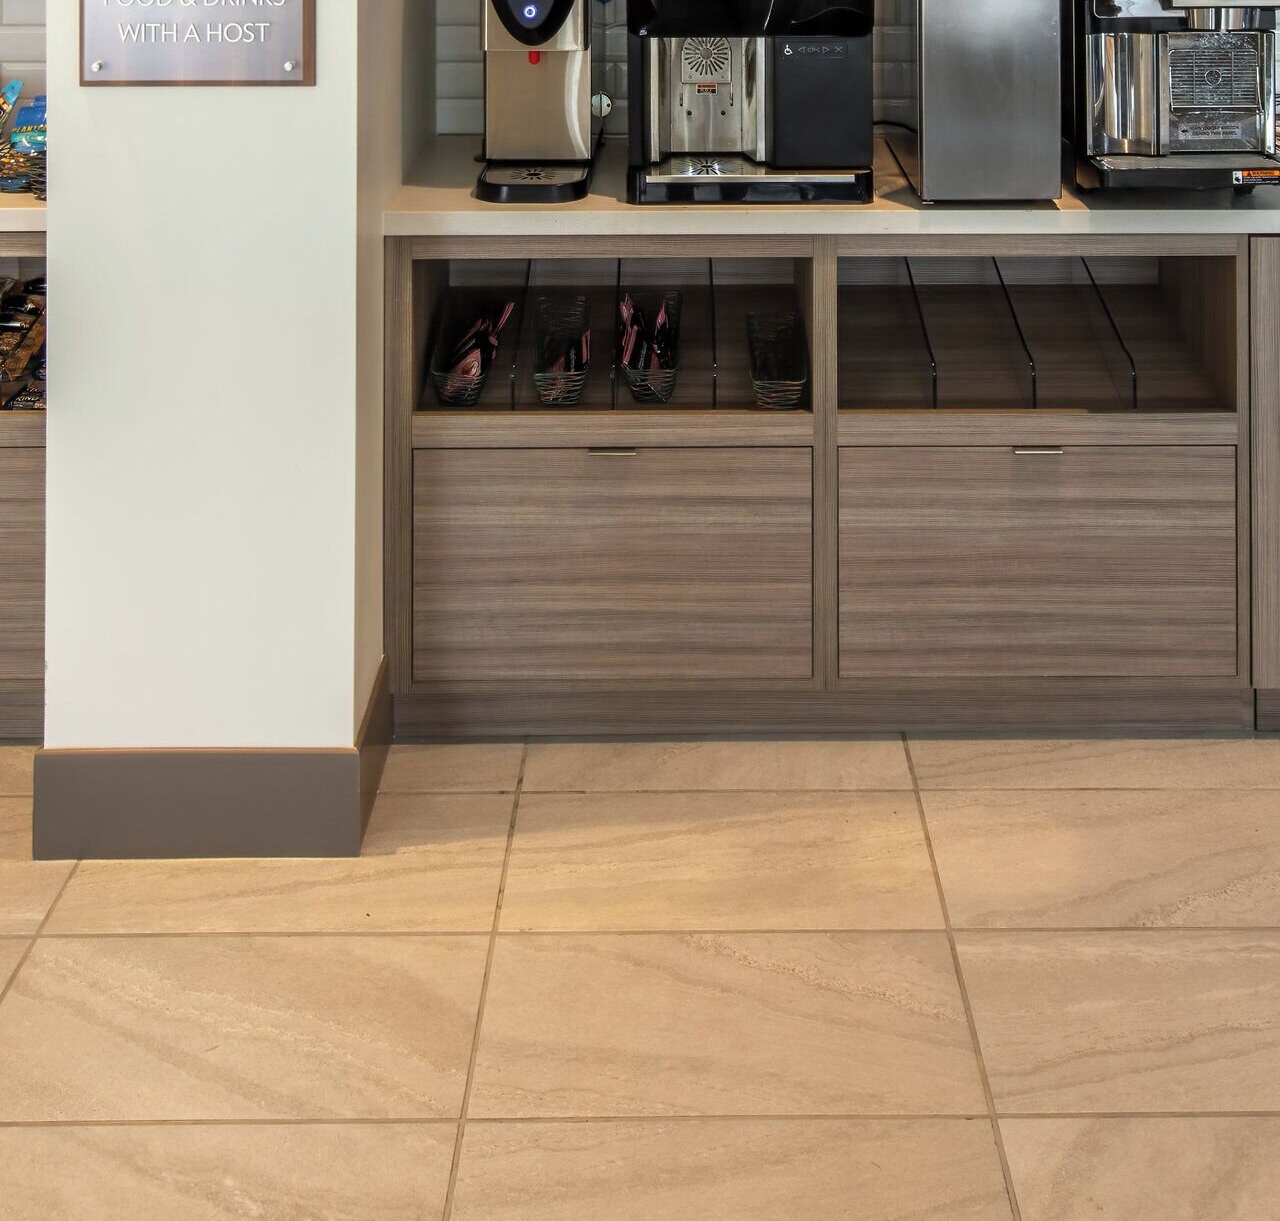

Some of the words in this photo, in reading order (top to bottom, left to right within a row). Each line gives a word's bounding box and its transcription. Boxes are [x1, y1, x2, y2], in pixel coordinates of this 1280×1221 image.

[118, 23, 177, 43] WITH
[183, 23, 202, 43] A
[207, 22, 271, 43] HOST
